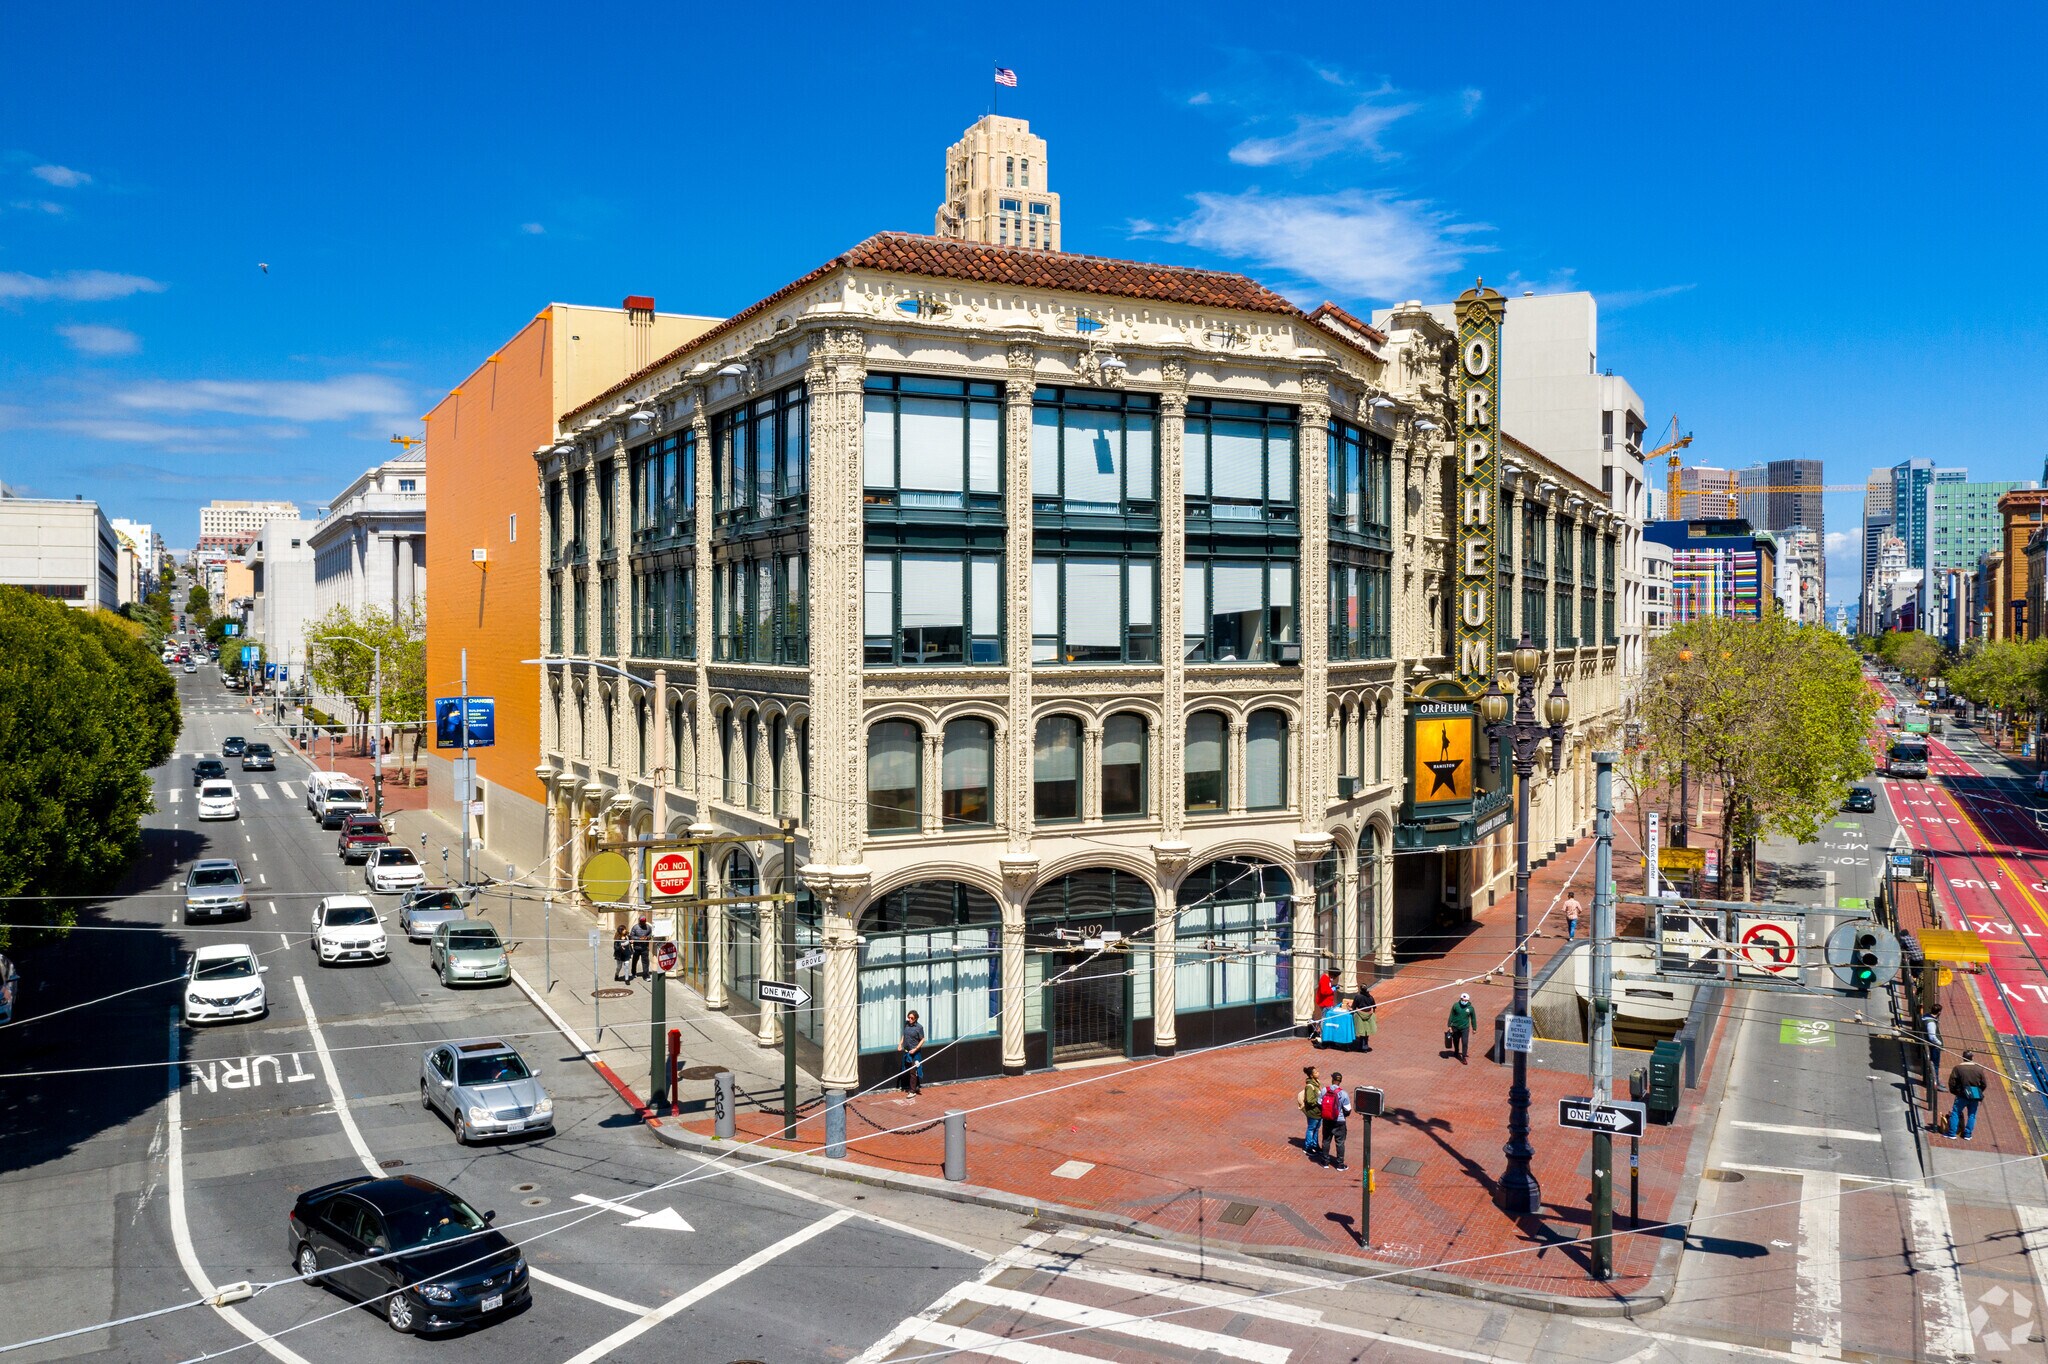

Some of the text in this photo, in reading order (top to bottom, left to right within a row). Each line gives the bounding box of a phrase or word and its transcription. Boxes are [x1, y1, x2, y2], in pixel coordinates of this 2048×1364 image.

[1461, 336, 1491, 676] ORPHEUM
[1420, 703, 1468, 714] ORPHEUM
[1902, 799, 1947, 807] TAXI
[1901, 815, 1960, 824] ONLY
[1824, 841, 1869, 851] MPH
[657, 862, 688, 871] DO NOT
[1815, 855, 1870, 866] ZONE
[660, 879, 684, 888] ENTER
[1949, 878, 2002, 891] BUS
[1077, 924, 1103, 938] 1192
[1958, 919, 2042, 937] TAXI
[801, 955, 822, 968] GROVE
[763, 986, 796, 999] ONE WAY
[190, 1053, 316, 1095] TURN
[1569, 1109, 1617, 1124] ONE WAY
